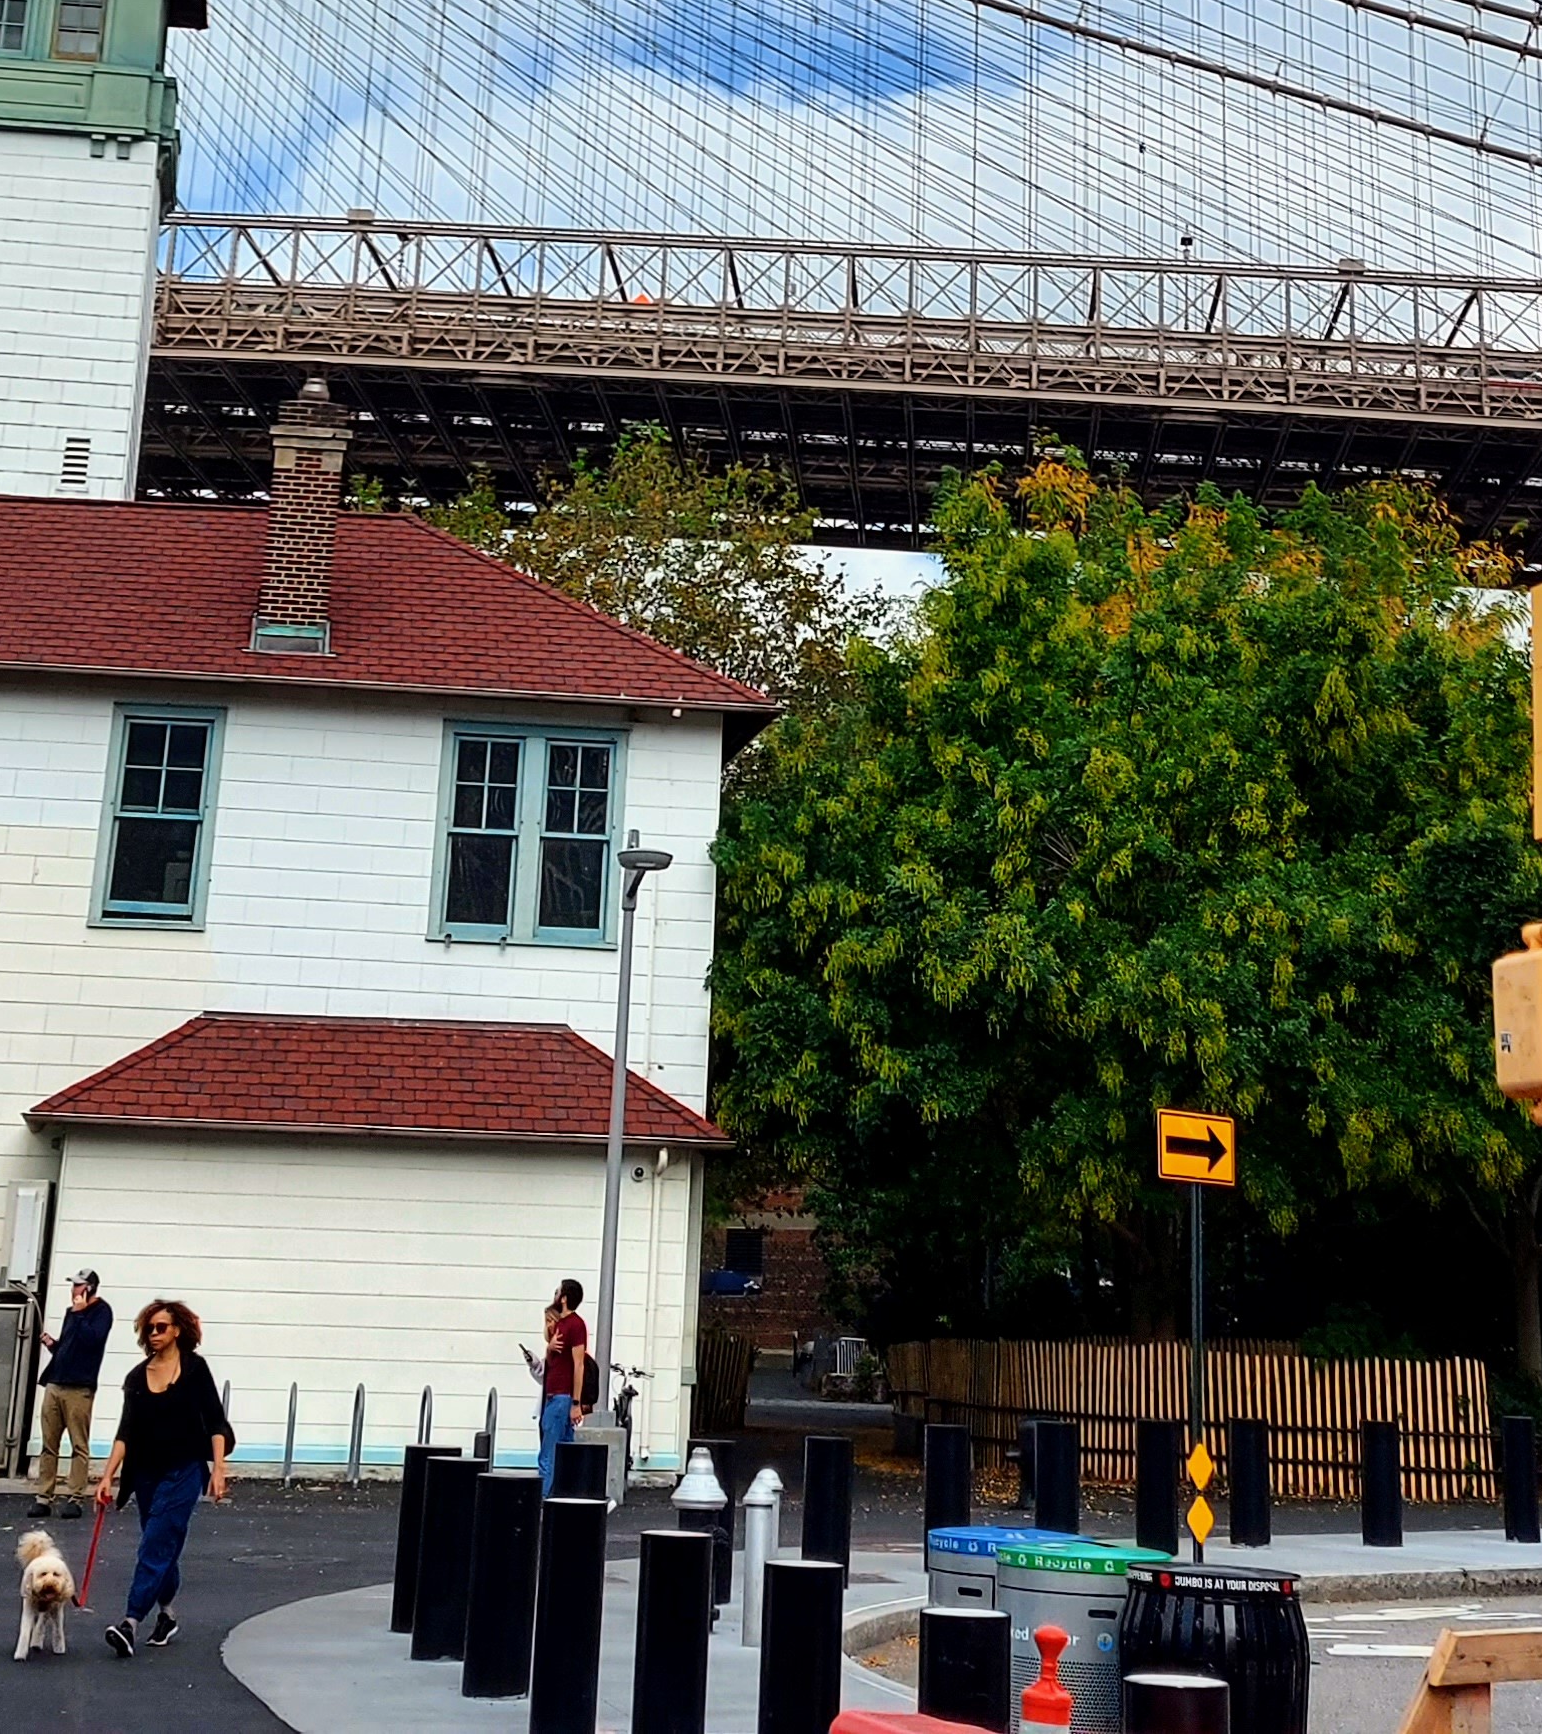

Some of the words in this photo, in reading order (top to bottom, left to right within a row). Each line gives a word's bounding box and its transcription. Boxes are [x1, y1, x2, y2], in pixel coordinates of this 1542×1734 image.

[1204, 1577, 1213, 1590] IS
[1214, 1578, 1224, 1590] AT
[1226, 1579, 1247, 1591] YOUR
